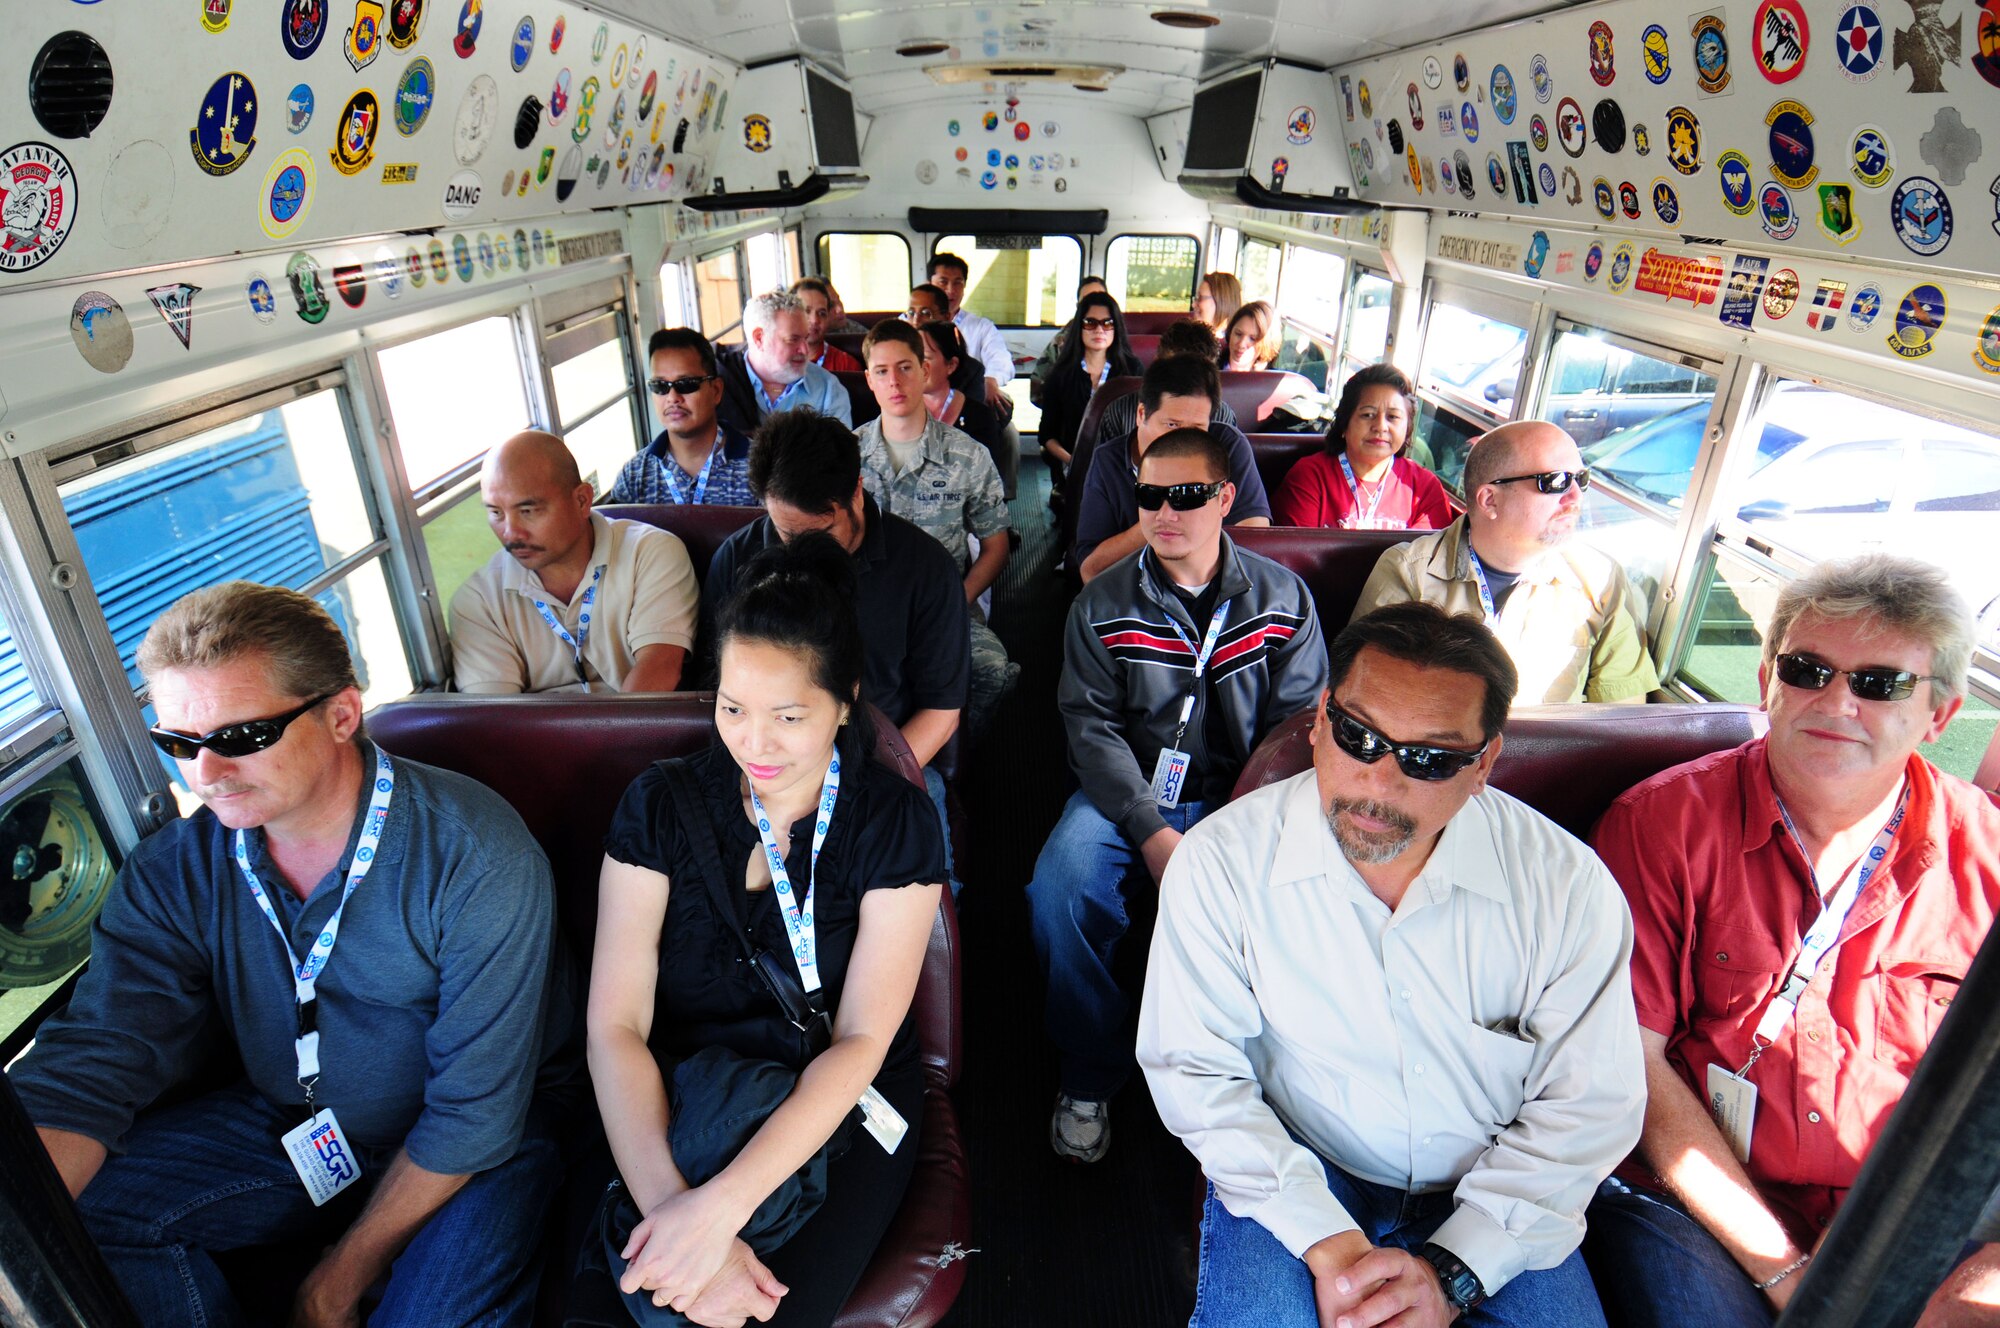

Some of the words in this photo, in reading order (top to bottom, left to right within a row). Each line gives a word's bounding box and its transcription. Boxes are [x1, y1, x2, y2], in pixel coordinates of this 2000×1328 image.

[1836, 62, 1857, 81] MARCH
[1858, 70, 1876, 82] FIELD
[1439, 109, 1453, 121] FAA
[0, 147, 69, 180] AVANNAH
[15, 165, 48, 180] GEORGIA
[197, 154, 211, 171] FLIGHT
[211, 166, 223, 175] TEST
[223, 151, 249, 174] SQUADRON
[48, 191, 60, 228] GUARD
[445, 184, 481, 205] DANG
[22, 228, 65, 267] DAWGS
[1438, 235, 1481, 262] EMERGENCY
[1481, 242, 1500, 268] EXIT
[1640, 247, 1701, 303] Semper
[1889, 337, 1900, 351] 605
[1901, 345, 1929, 356] AMXS
[929, 493, 940, 501] AIR
[943, 493, 961, 501] FORCE
[1162, 757, 1184, 802] ESGR
[298, 1138, 306, 1149] THE
[304, 1148, 314, 1166] GUARD
[317, 1174, 330, 1196] RESERVE
[304, 1135, 318, 1160] EMPLOYER
[317, 1159, 329, 1181] SUPPORT
[328, 1180, 333, 1188] OF
[310, 1122, 354, 1187] ESGR
